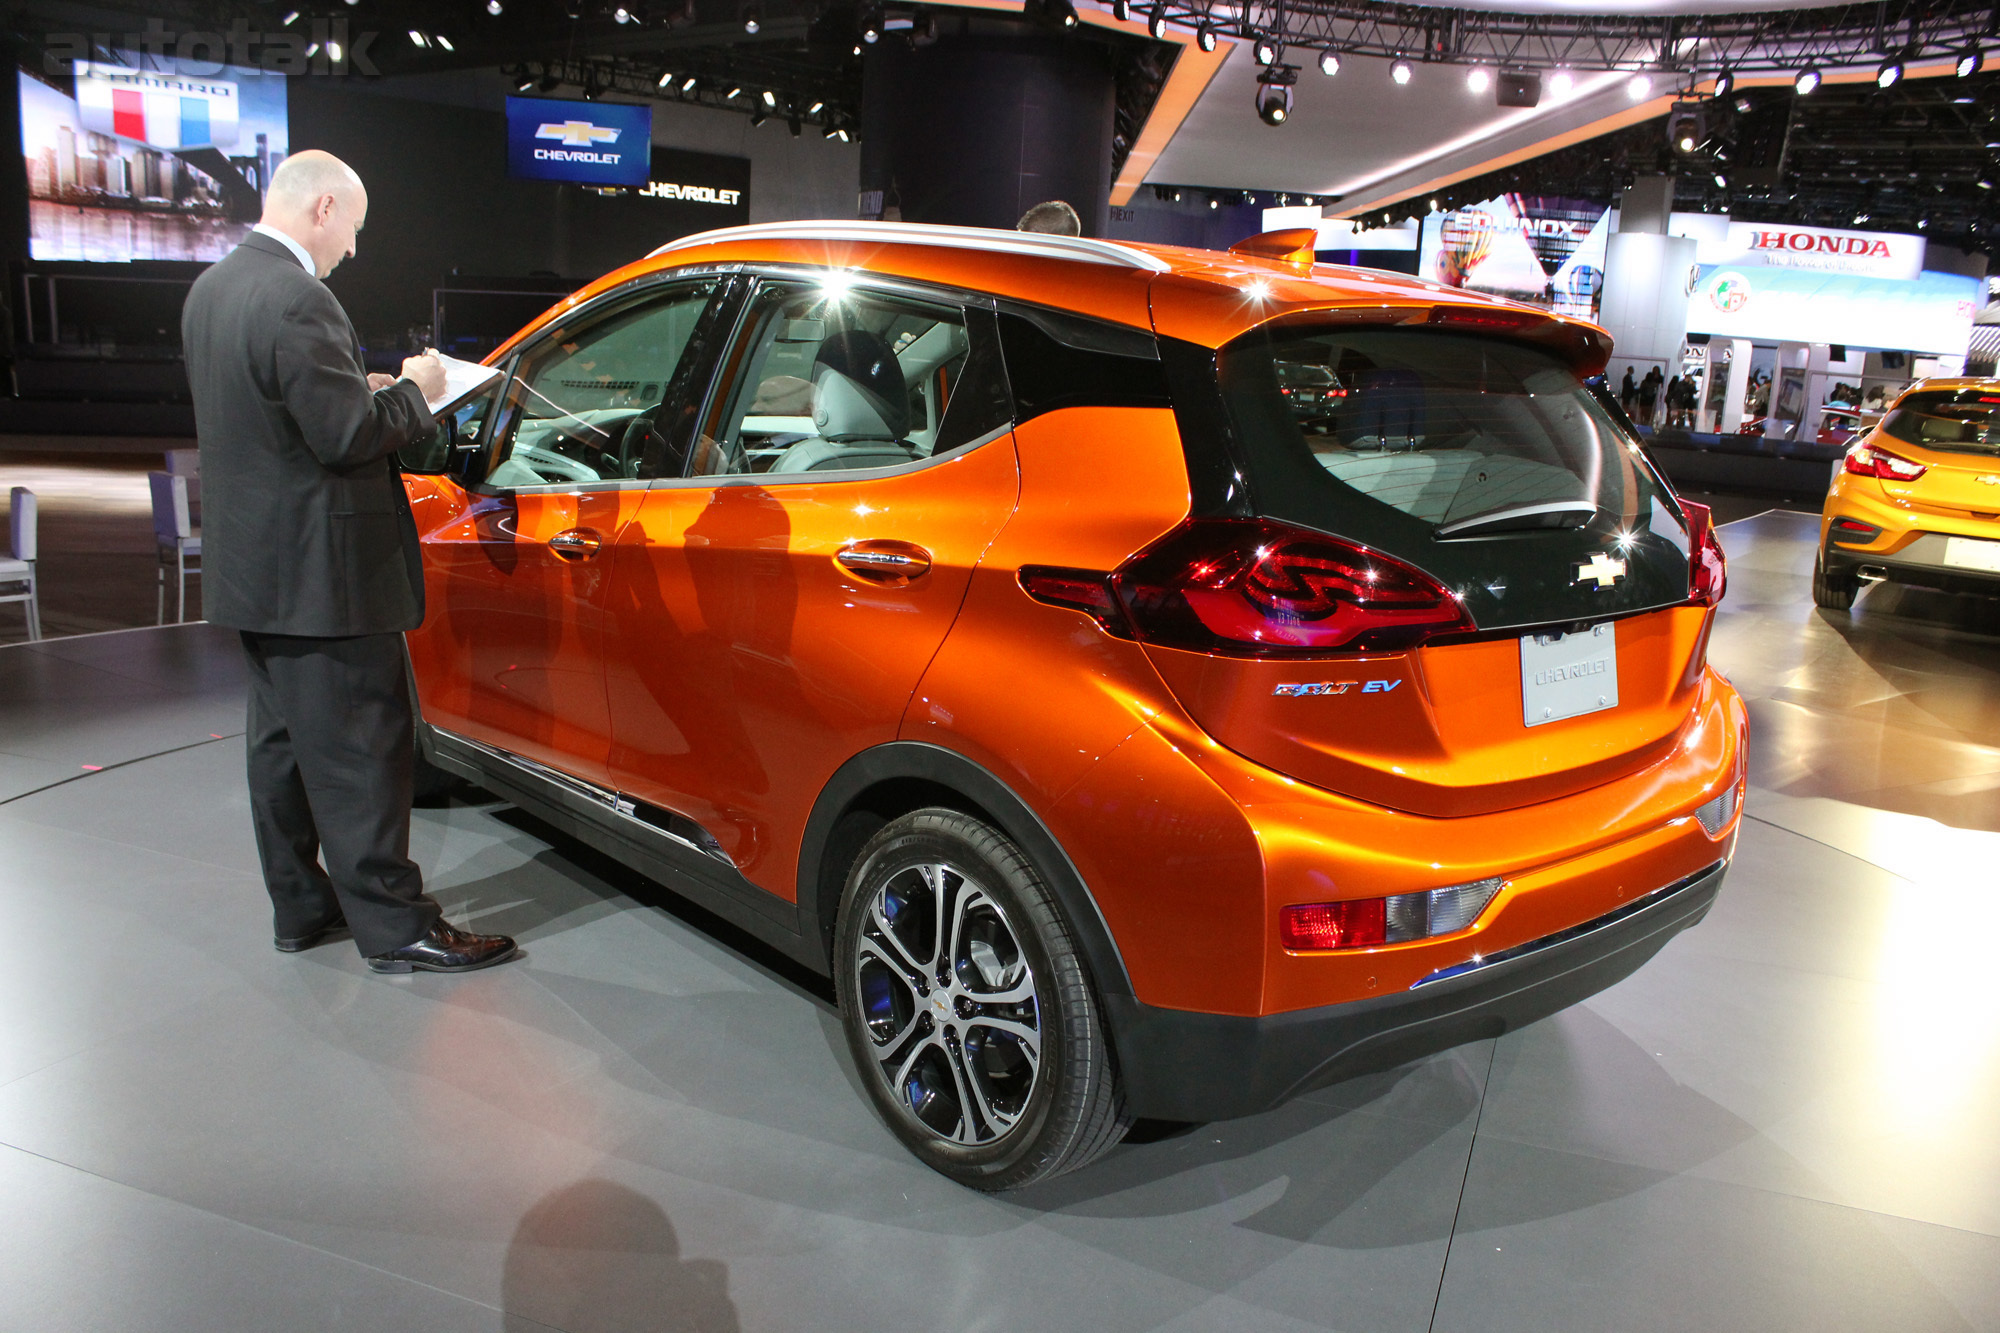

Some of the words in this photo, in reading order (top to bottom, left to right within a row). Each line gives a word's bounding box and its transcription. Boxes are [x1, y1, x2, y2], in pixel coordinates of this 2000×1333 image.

[86, 70, 231, 97] CAMARO
[534, 148, 621, 165] CHEVROLET
[1118, 208, 1135, 222] EXIT
[1455, 213, 1578, 238] EQUINOX
[1756, 231, 1892, 258] HONDA
[1535, 656, 1609, 686] CHEVROLET
[1272, 680, 1359, 697] BOLT
[1361, 679, 1402, 693] EV
